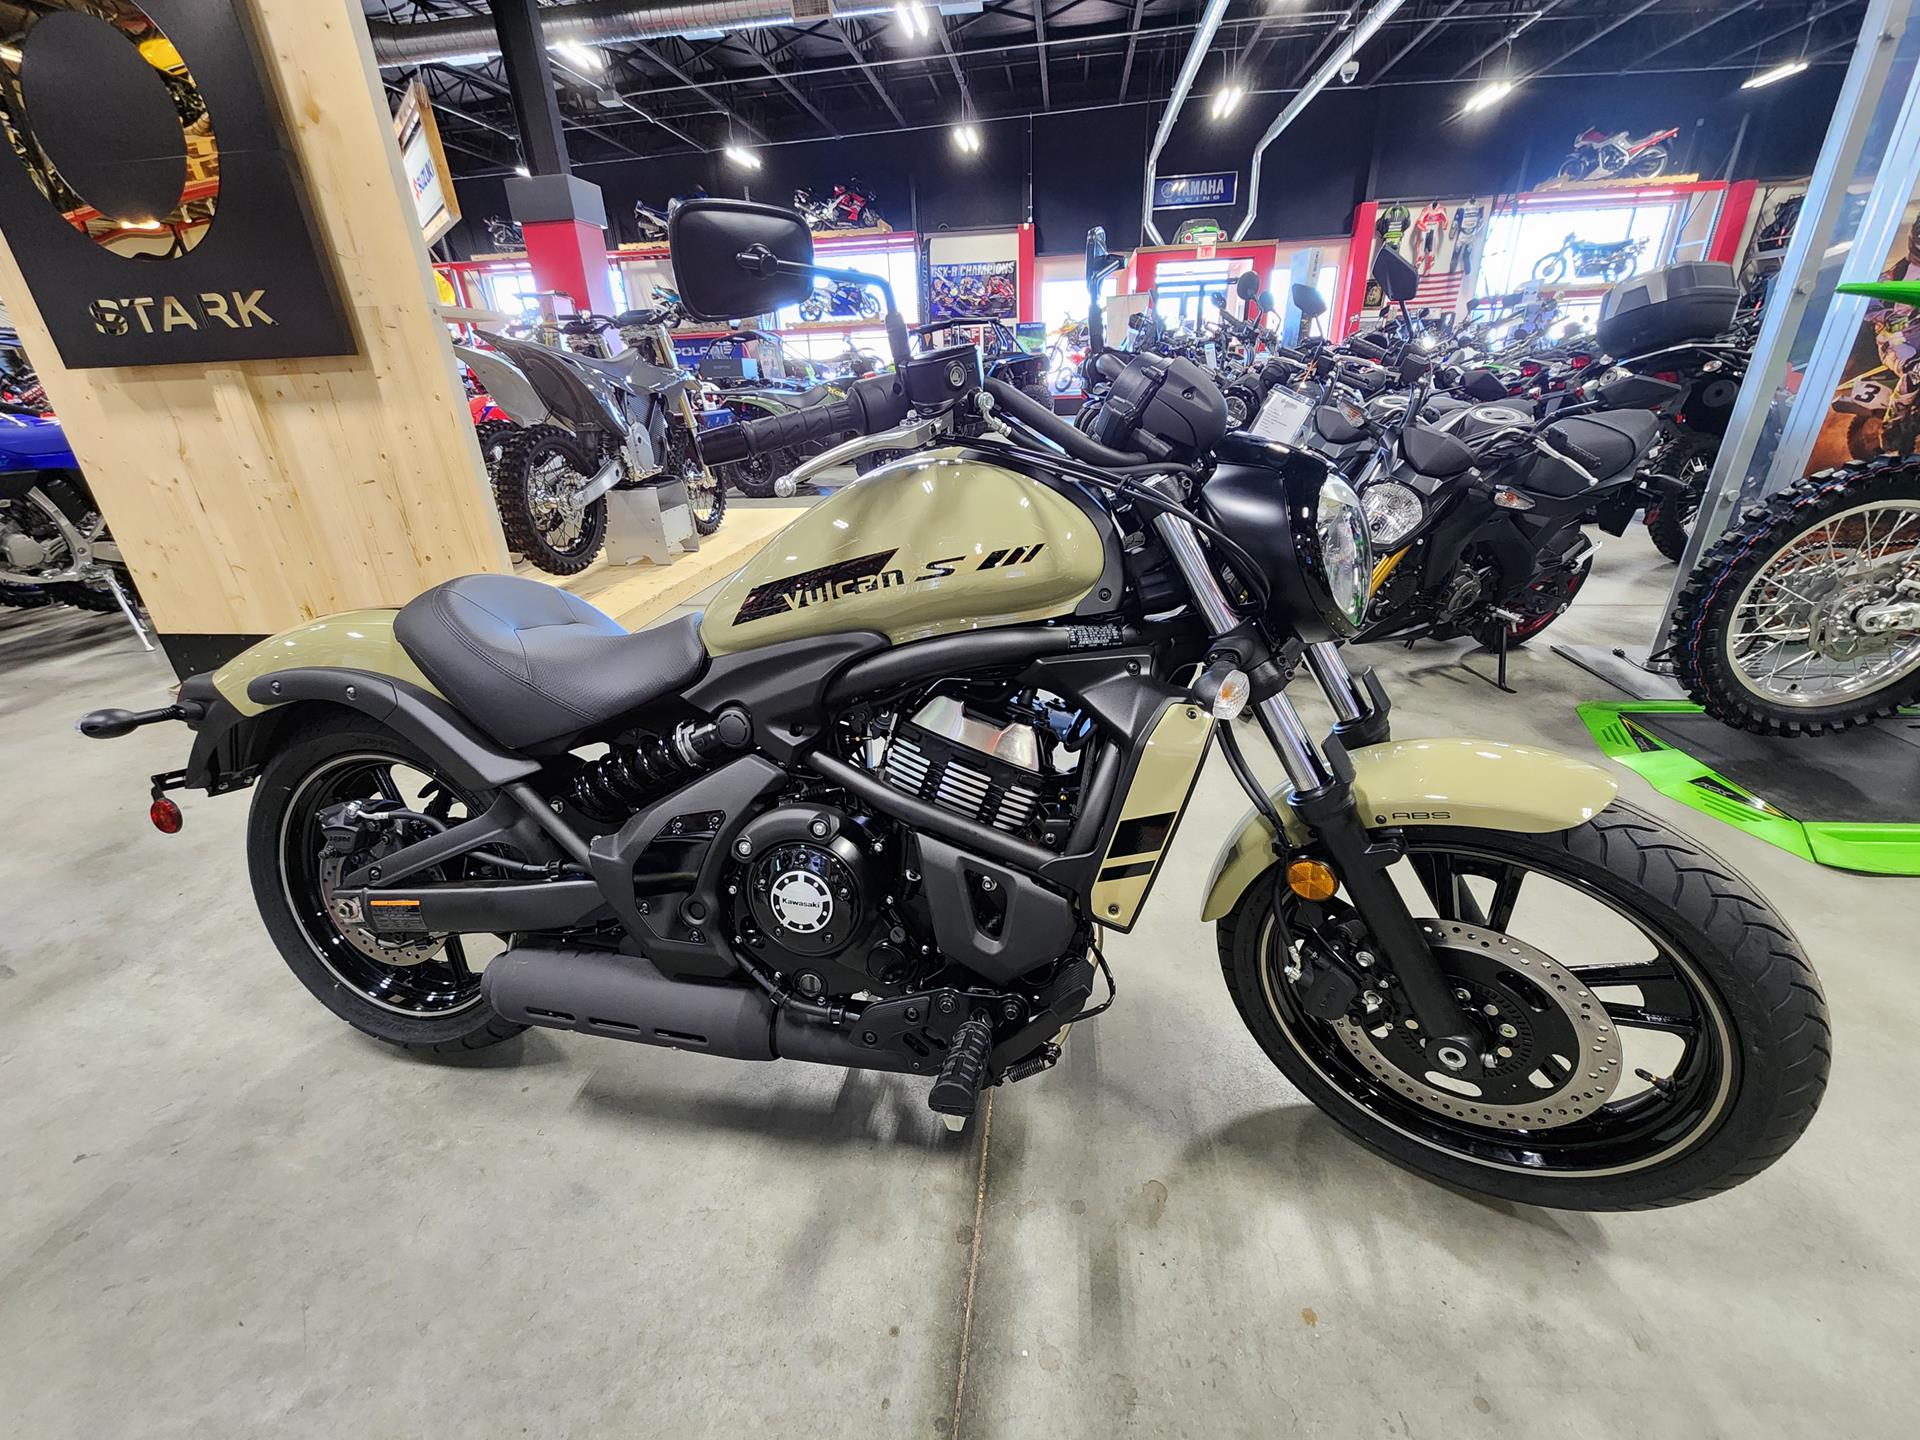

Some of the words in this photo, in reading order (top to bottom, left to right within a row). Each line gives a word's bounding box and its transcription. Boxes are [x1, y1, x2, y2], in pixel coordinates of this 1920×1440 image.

[1174, 178, 1224, 197] YAMAHA
[960, 262, 1015, 276] CHAMPIONS
[88, 289, 279, 337] STARK
[1854, 383, 1881, 403] 3
[783, 568, 904, 611] Vulcan
[915, 555, 967, 582] S
[1392, 811, 1451, 820] ABS
[782, 897, 820, 908] Kawasaki
